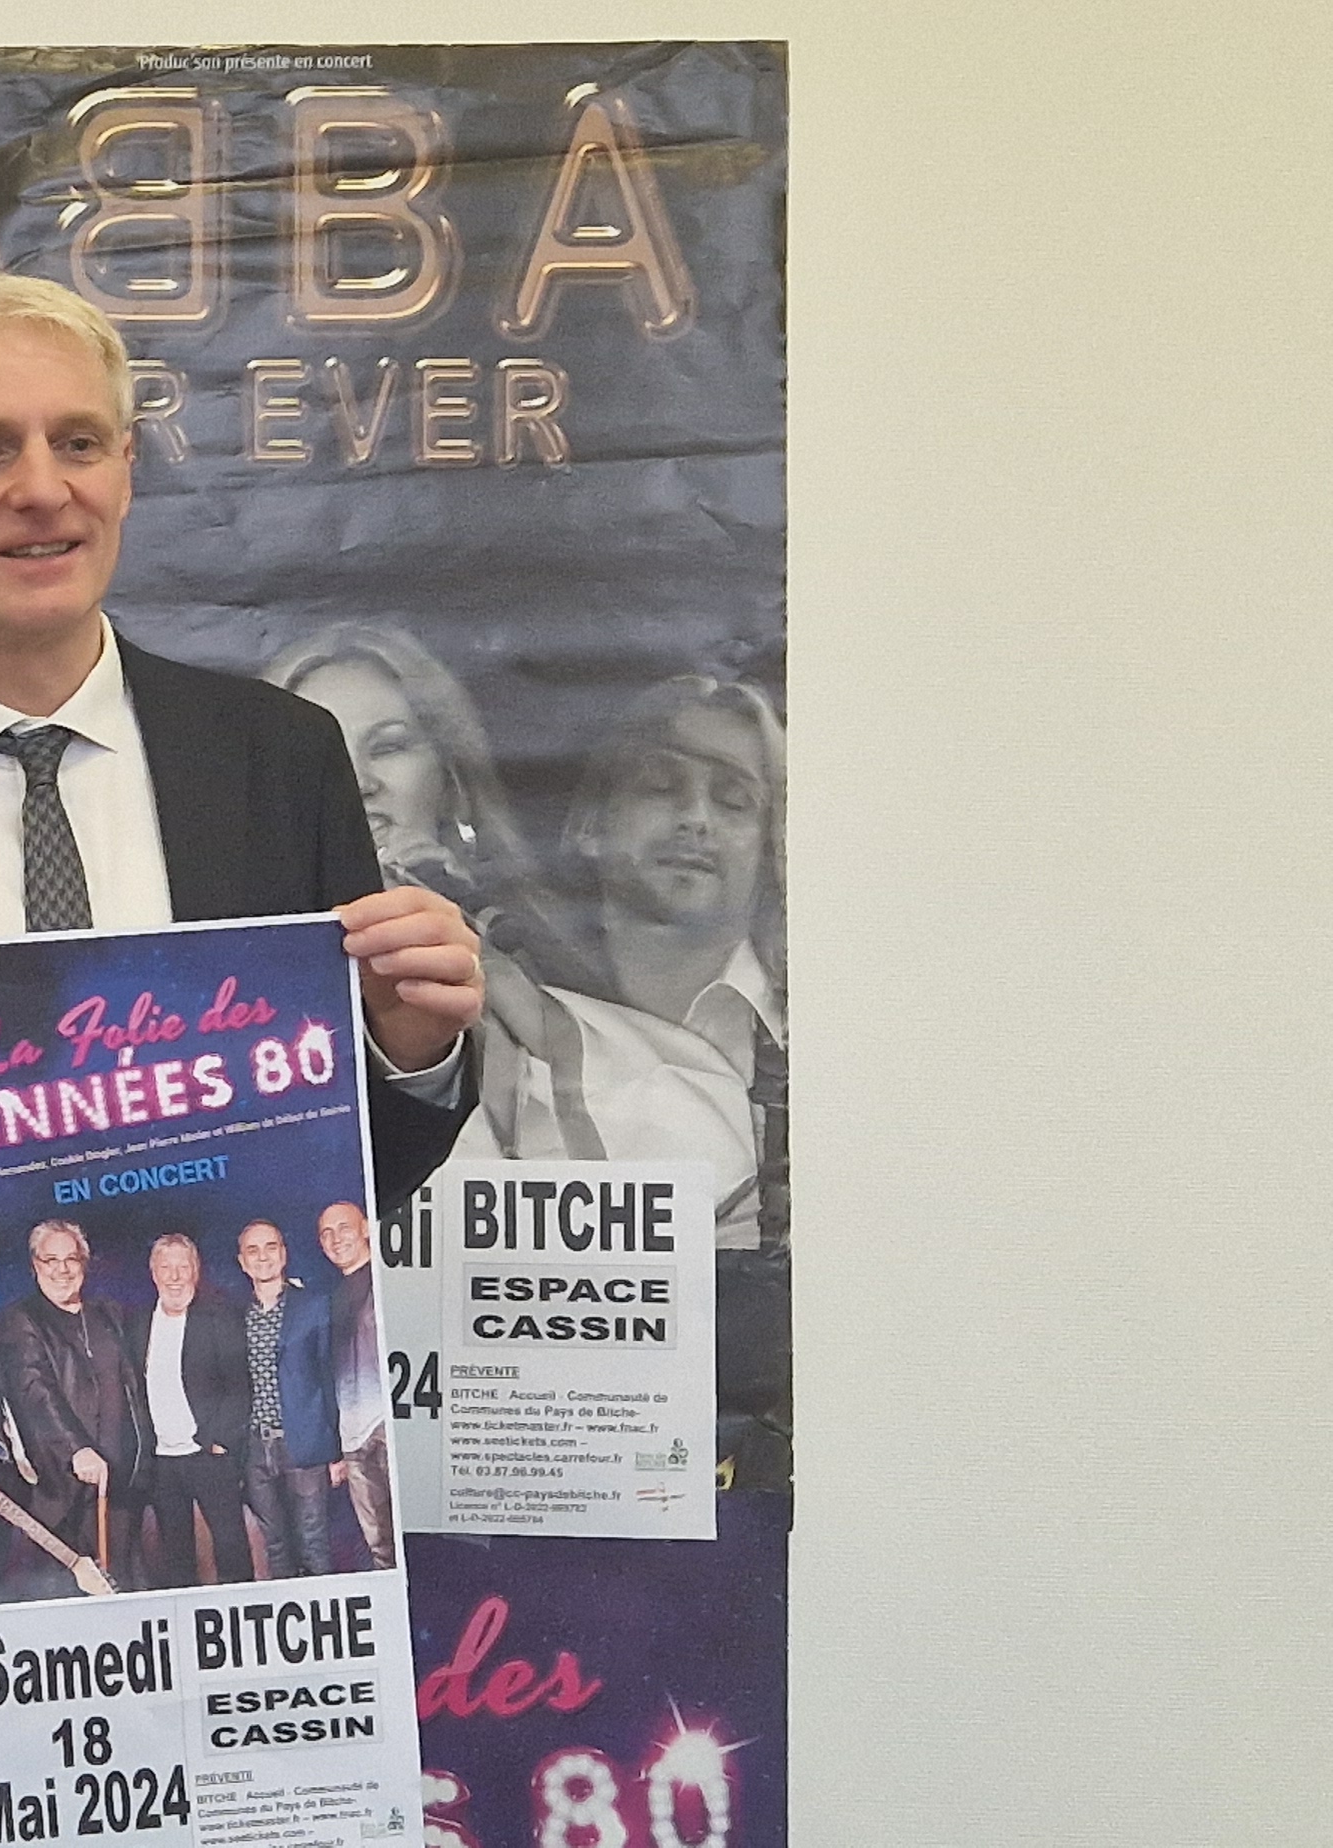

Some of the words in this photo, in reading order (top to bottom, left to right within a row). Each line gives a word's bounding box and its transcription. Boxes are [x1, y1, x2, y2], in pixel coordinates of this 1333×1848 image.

[225, 54, 289, 74] présente
[294, 56, 313, 70] en
[317, 54, 373, 69] concert
[242, 354, 571, 470] EVER
[57, 991, 186, 1067] Folie
[198, 976, 277, 1035] des
[252, 1017, 338, 1099] 80
[53, 1179, 91, 1205] EN
[99, 1154, 229, 1198] CONCERT
[464, 1180, 675, 1252] BITCHE
[471, 1277, 670, 1303] ESPACE
[473, 1316, 666, 1342] CASSIN
[450, 1365, 519, 1379] PRÉVENTE
[451, 1389, 498, 1400] BITCHE
[509, 1390, 555, 1401] Accueil
[567, 1390, 650, 1403] Communauté
[654, 1393, 668, 1403] de
[451, 1404, 521, 1416] Communes
[525, 1407, 541, 1416] du
[545, 1407, 573, 1420] Pays
[578, 1407, 593, 1417] de
[451, 1420, 573, 1432] www.ticketmaster.fr
[587, 1422, 659, 1433] www.fnac.fr
[451, 1436, 577, 1448] www.seetickets.com
[451, 1452, 623, 1464] www.spectacles.carrefour.fr
[195, 1595, 375, 1670] BITCHE
[417, 1595, 603, 1720] des
[207, 1682, 376, 1716] ESPACE
[51, 1716, 112, 1768] 18
[211, 1715, 375, 1749] CASSIN
[75, 1764, 191, 1836] 2024
[197, 1792, 237, 1804] BITCHE
[276, 1801, 301, 1812] Pays
